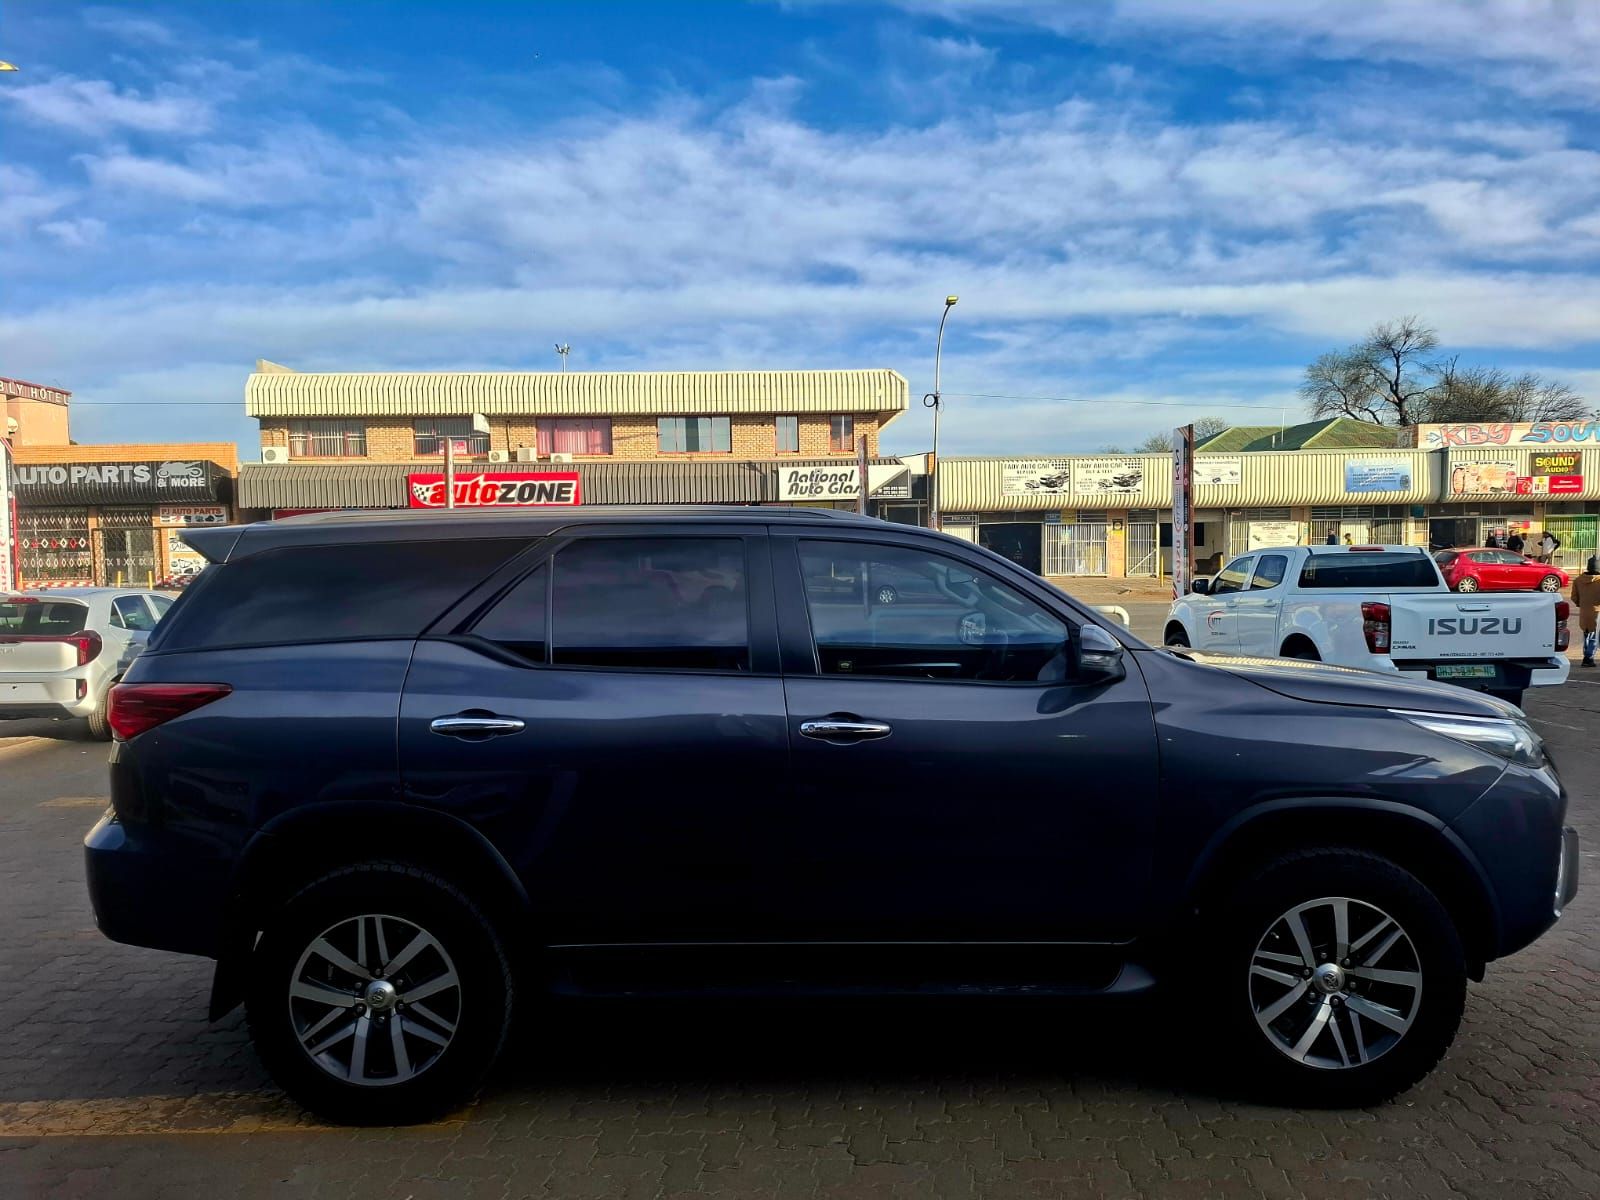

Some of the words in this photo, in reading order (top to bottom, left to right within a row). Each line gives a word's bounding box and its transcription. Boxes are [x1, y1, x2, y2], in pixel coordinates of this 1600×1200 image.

[30, 387, 70, 405] HOTEL
[1440, 424, 1513, 446] KBY
[1521, 420, 1600, 443] SOU
[1535, 456, 1575, 467] SOUND
[70, 465, 152, 483] PARTS
[787, 469, 854, 484] National
[1544, 466, 1569, 474] AUDIO
[157, 479, 167, 488] &
[171, 478, 205, 487] MORE
[787, 482, 824, 495] Auto
[1428, 617, 1522, 636] ISUZU
